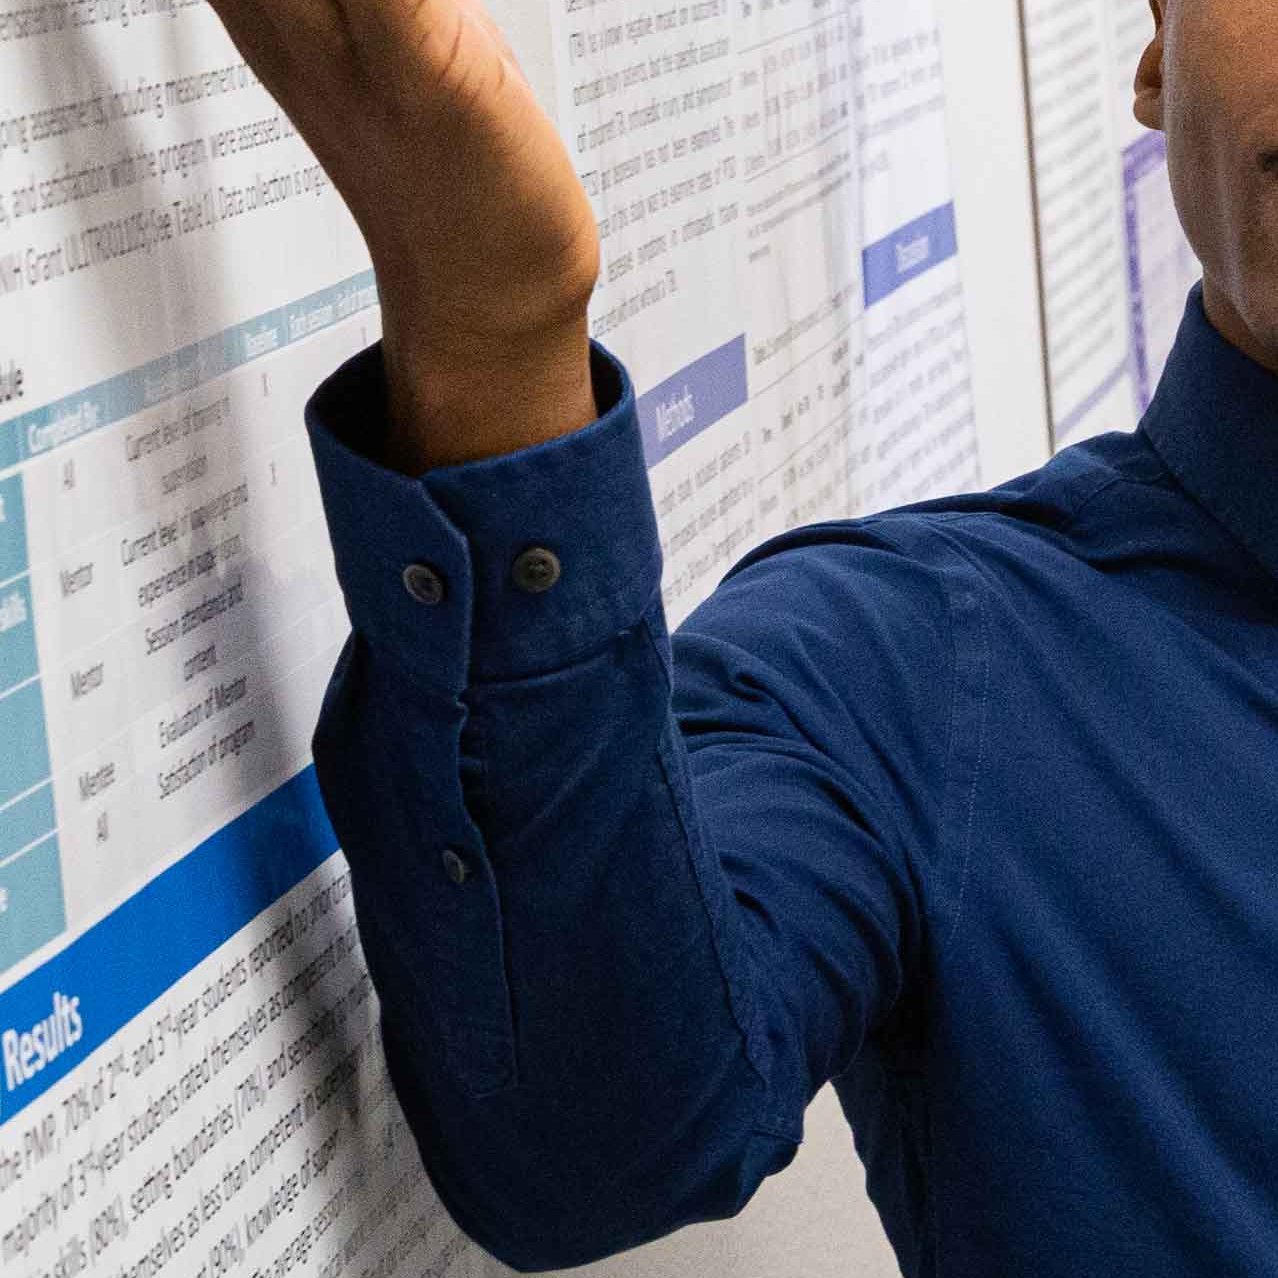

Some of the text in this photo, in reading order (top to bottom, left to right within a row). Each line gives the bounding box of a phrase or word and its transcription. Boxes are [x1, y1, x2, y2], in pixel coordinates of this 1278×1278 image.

[159, 137, 208, 184] program
[217, 186, 247, 220] Data
[59, 554, 94, 600] Mentor
[70, 656, 104, 704] Mentor
[158, 697, 204, 751] Evaluation
[3, 992, 83, 1092] Results
[2, 1191, 58, 1266] majority
[61, 1161, 78, 1213] of
[127, 1082, 178, 1154] students
[180, 1054, 208, 1103] rated
[209, 1001, 268, 1078] themselves
[130, 1160, 174, 1224] setting
[174, 1101, 234, 1183] boundaries
[267, 1041, 287, 1093] and
[186, 1203, 200, 1241] as
[201, 1181, 222, 1224] less
[222, 1156, 246, 1204] than
[248, 1099, 304, 1178] competent
[245, 1170, 300, 1249] knowledge
[300, 1146, 309, 1192] of
